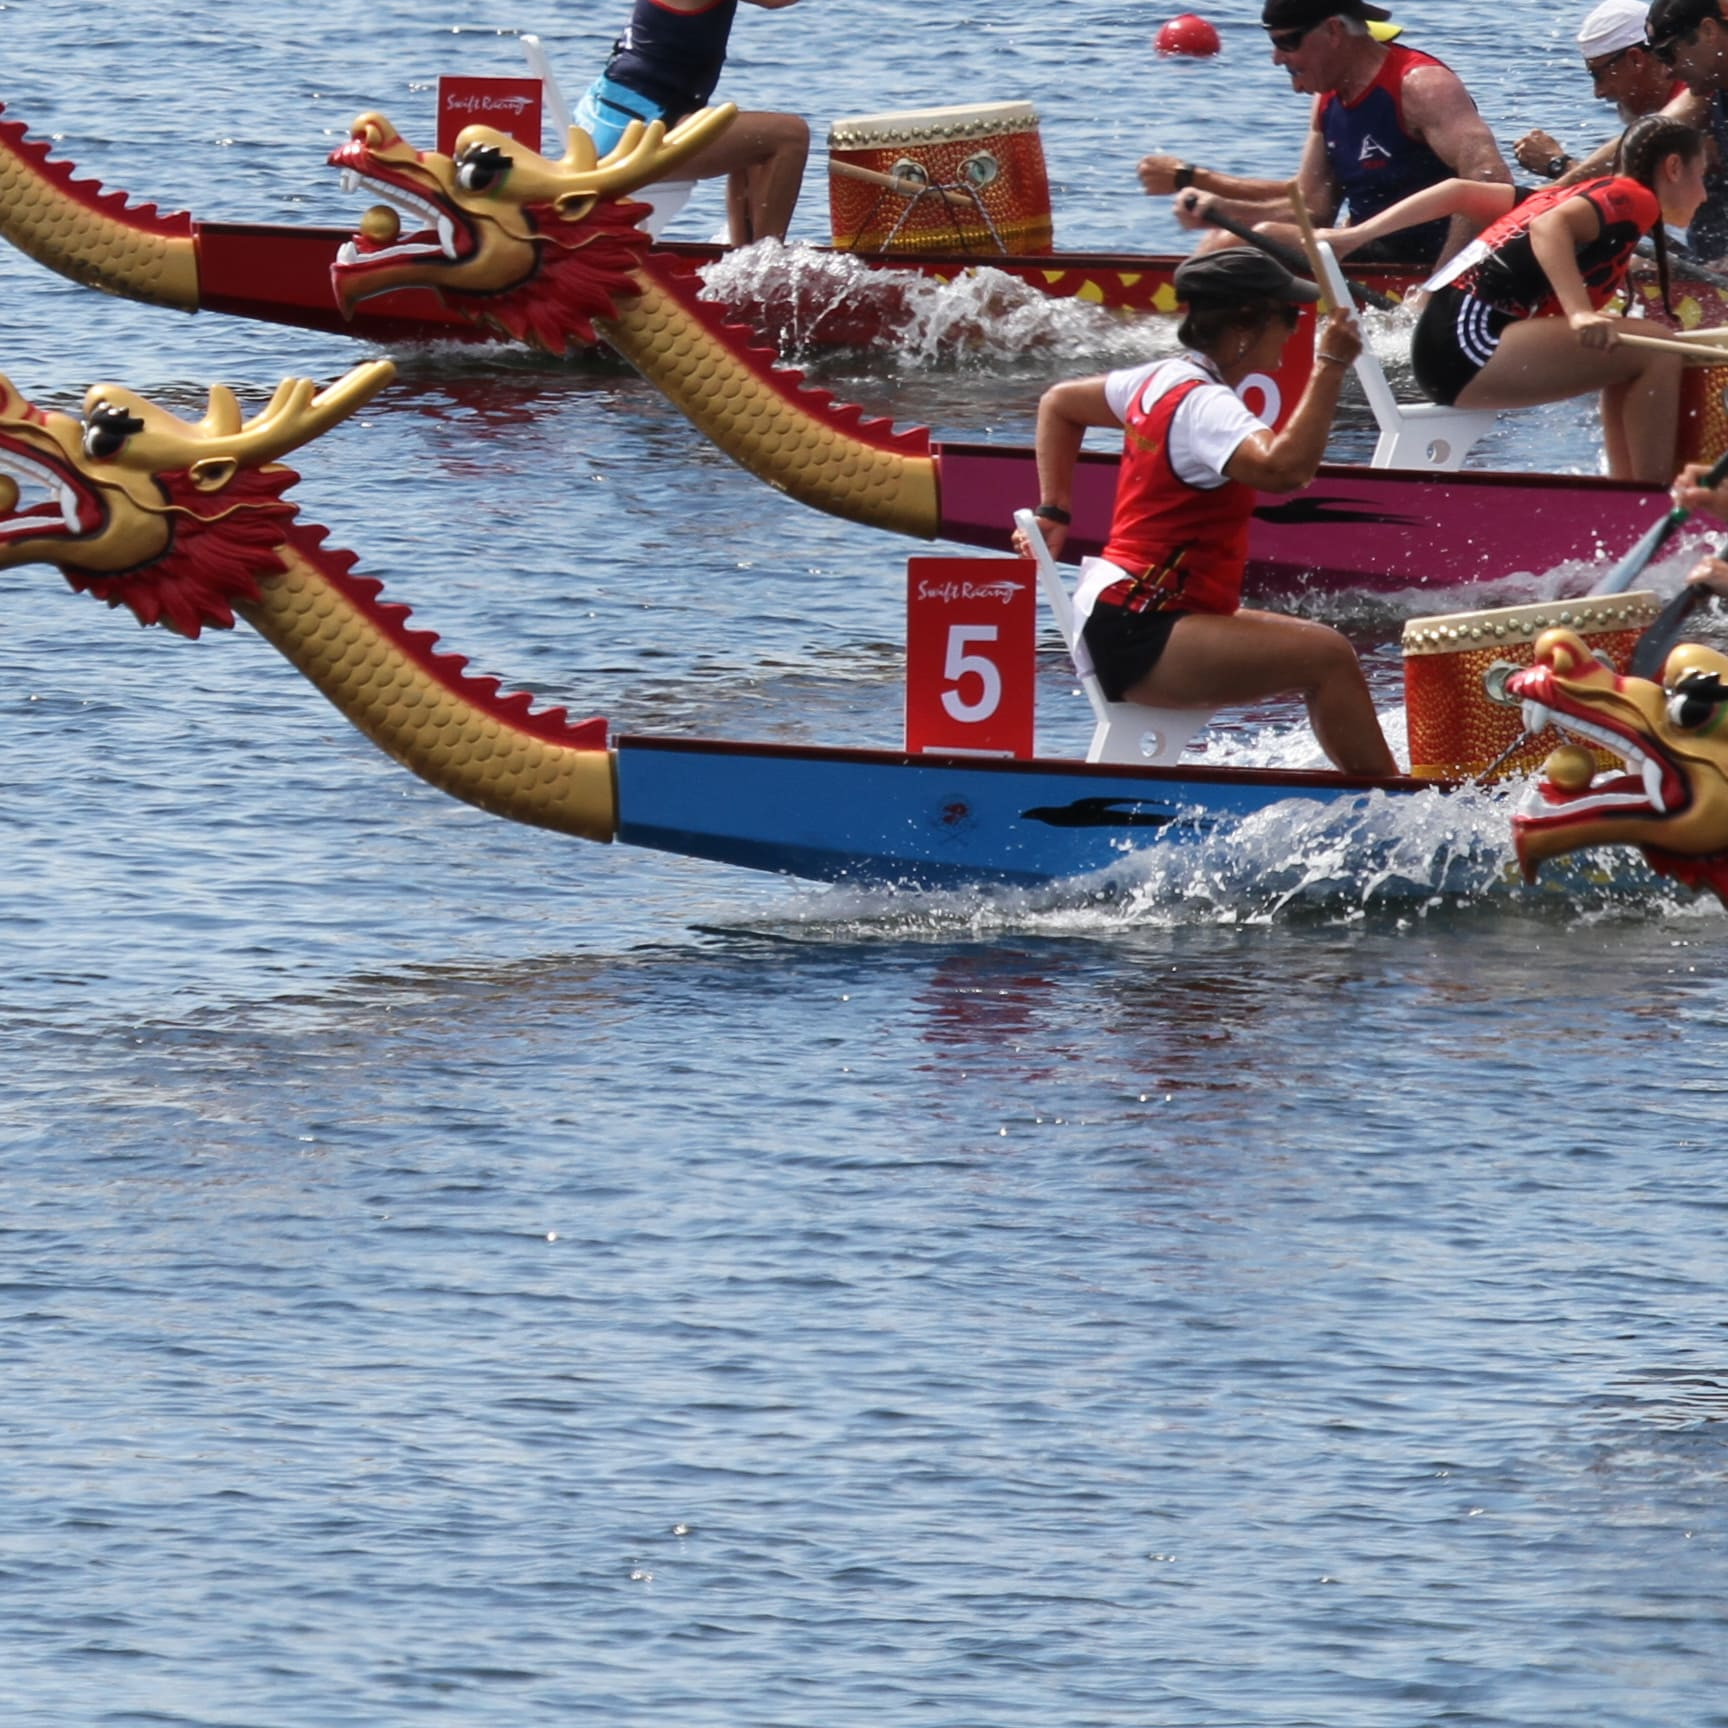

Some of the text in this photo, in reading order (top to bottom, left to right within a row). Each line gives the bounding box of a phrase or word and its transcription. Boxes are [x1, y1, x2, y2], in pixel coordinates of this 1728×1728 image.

[447, 93, 526, 116] Swift Racing
[918, 579, 1016, 605] Swift Racing
[940, 624, 1002, 723] 5
